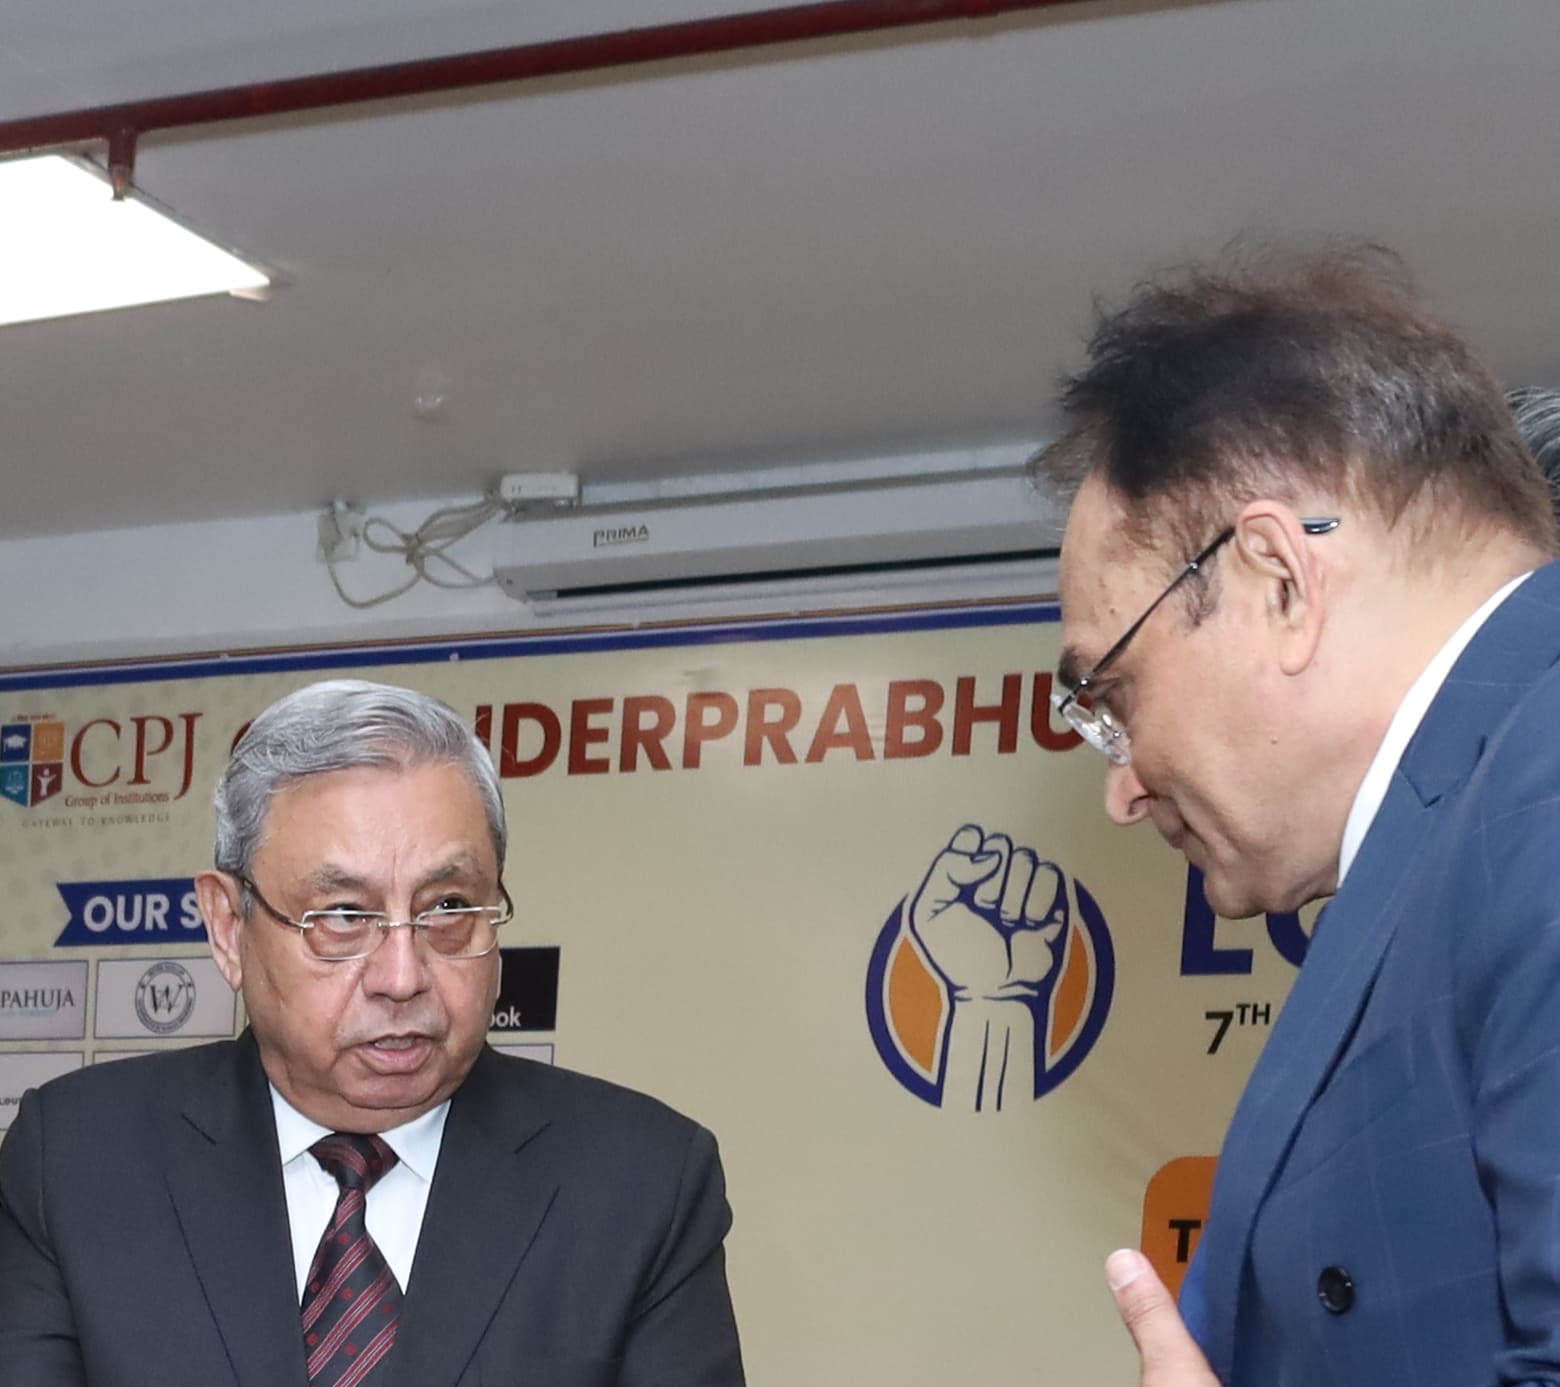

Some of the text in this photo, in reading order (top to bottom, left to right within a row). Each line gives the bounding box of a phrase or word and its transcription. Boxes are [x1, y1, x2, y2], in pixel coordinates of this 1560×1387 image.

[593, 525, 650, 548] PRIMA
[475, 671, 1091, 780] DERPRABHU
[70, 712, 203, 800] CPJ
[65, 792, 169, 809] Group of Institutions
[101, 813, 170, 825] KNOWLEDGE
[83, 893, 170, 932] OUR
[0, 988, 75, 1011] PAHUJA
